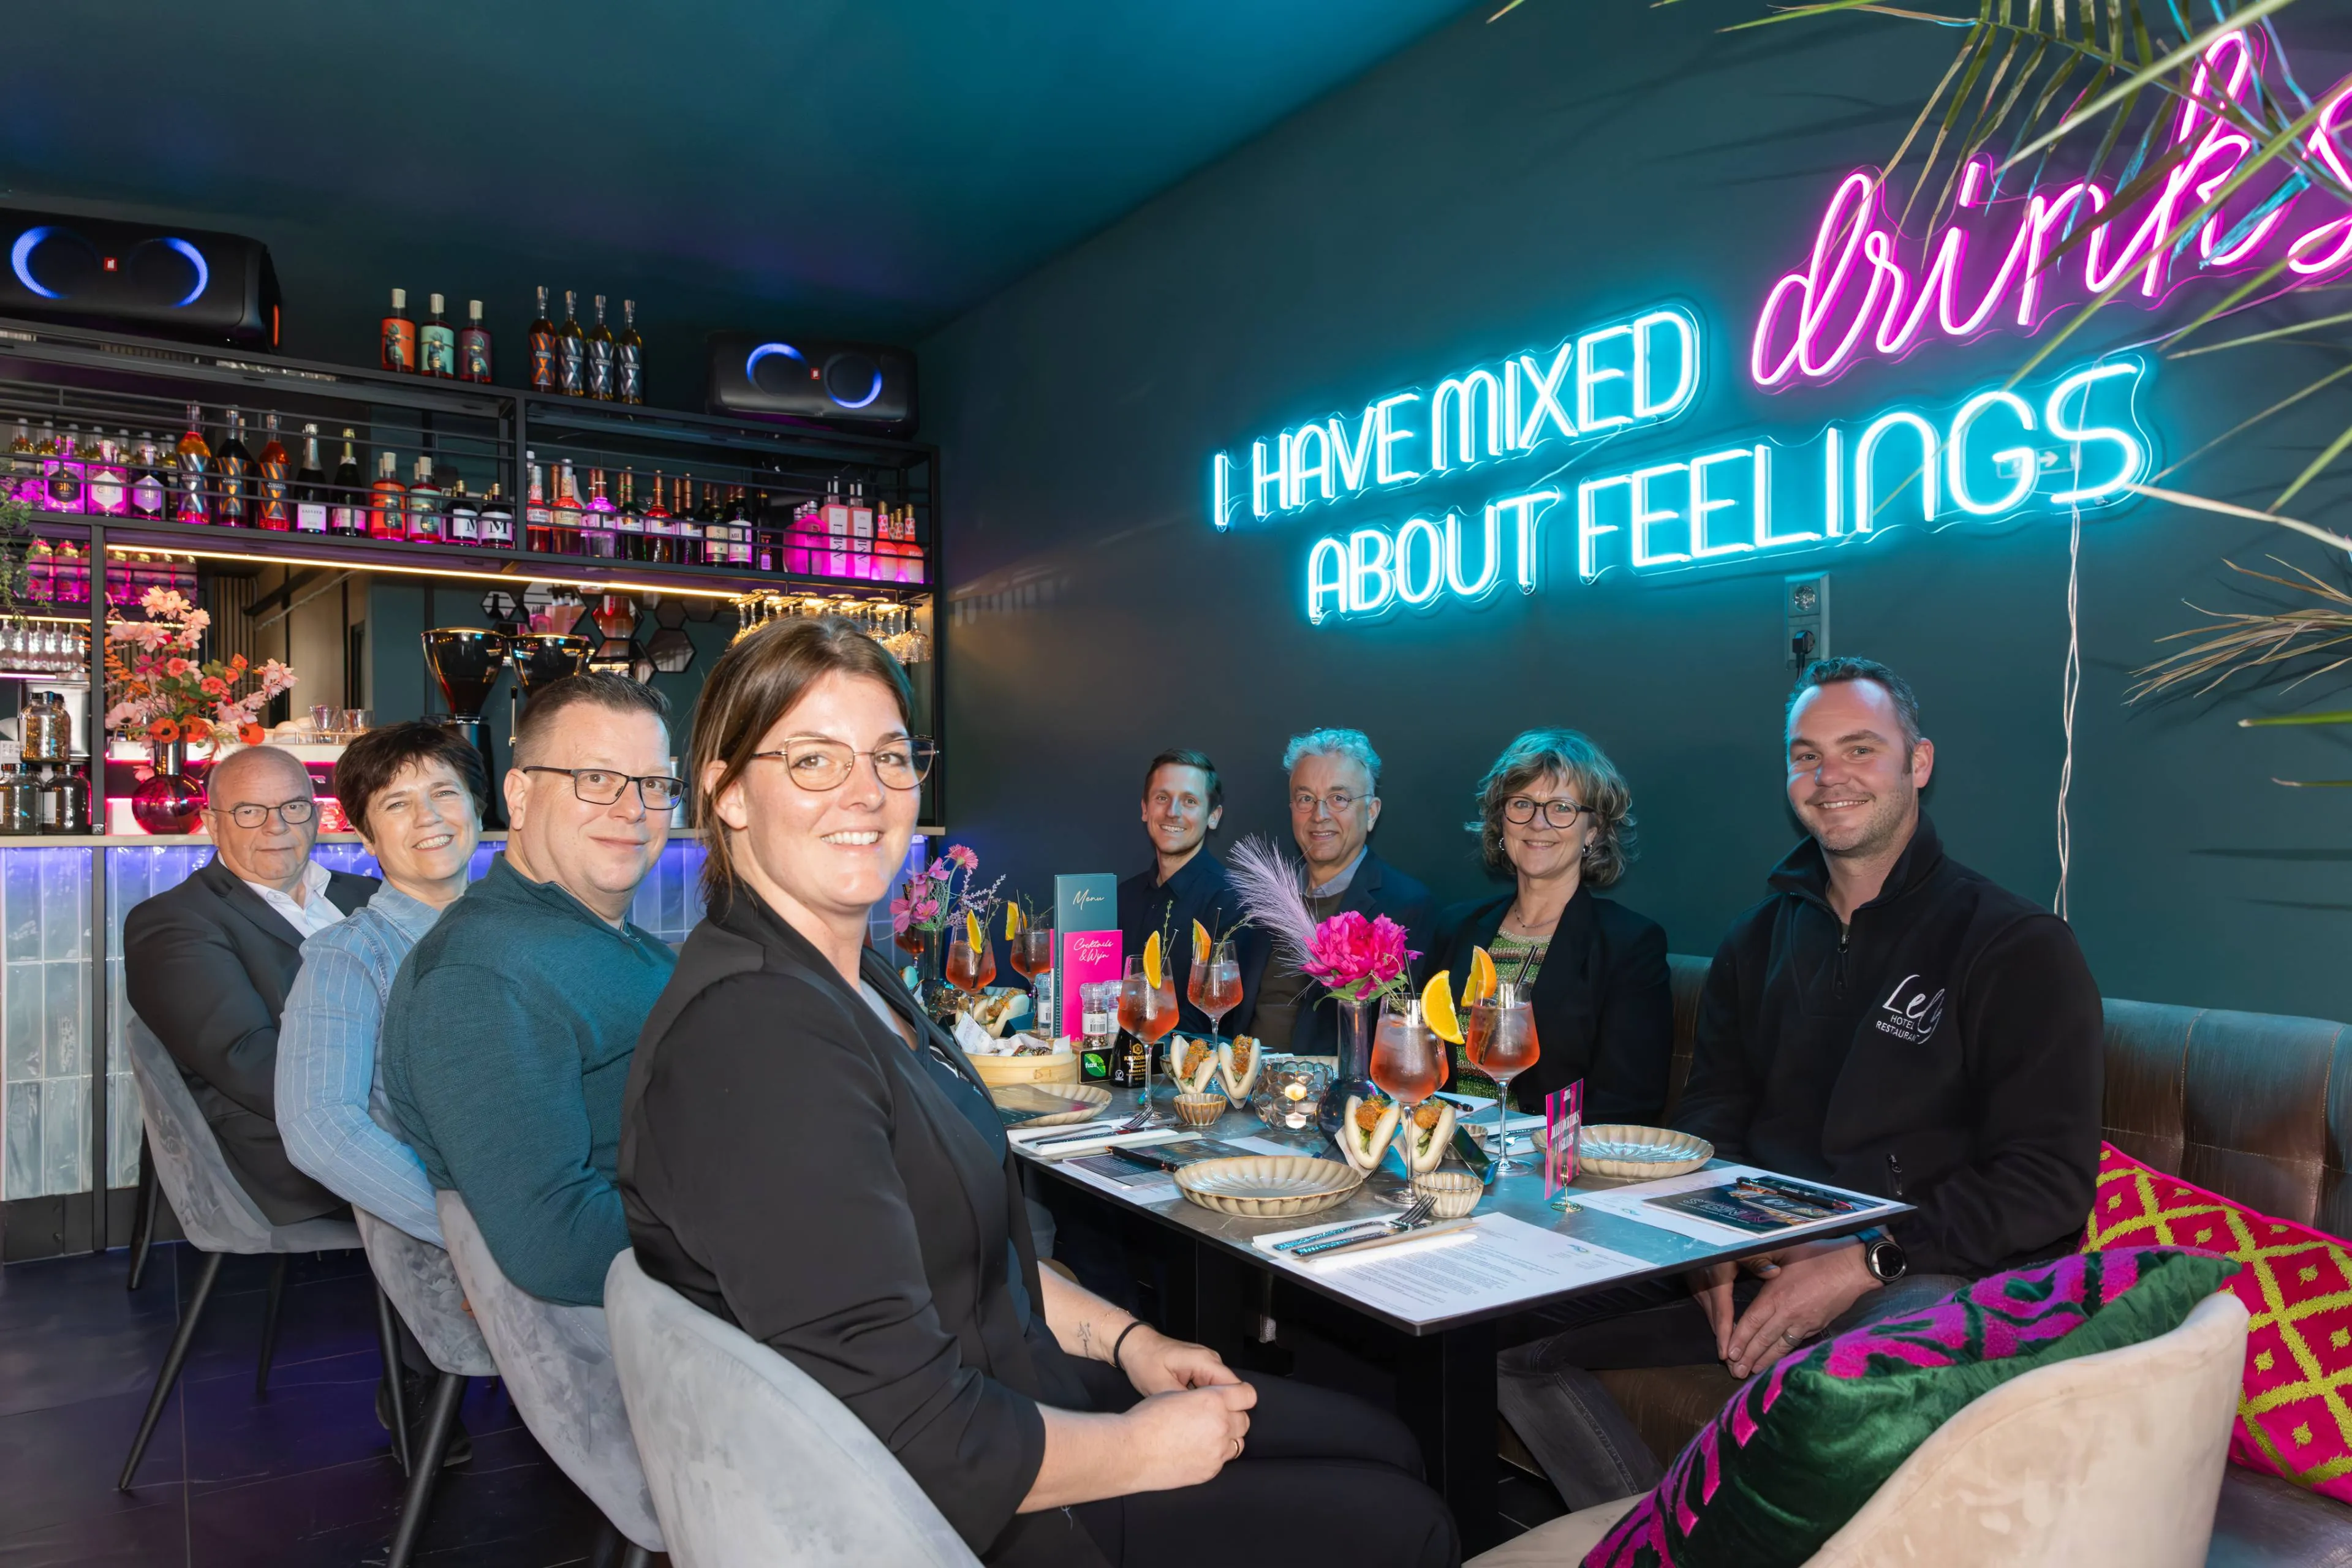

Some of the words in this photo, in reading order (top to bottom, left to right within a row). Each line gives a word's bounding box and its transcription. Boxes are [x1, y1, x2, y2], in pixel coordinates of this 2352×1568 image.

[1214, 452, 1229, 527] I
[1252, 392, 1420, 517] HAVE
[1432, 311, 1697, 470] MIXED
[1751, 29, 2352, 386] drinks
[54, 482, 74, 492] GIN
[96, 486, 116, 495] GIN
[1309, 490, 1562, 620] ABOUT
[1578, 364, 2147, 579] FEELINGS
[1072, 888, 1105, 911] Menu
[1073, 937, 1114, 951] Cocktails
[1890, 1014, 1916, 1030] HOTEL
